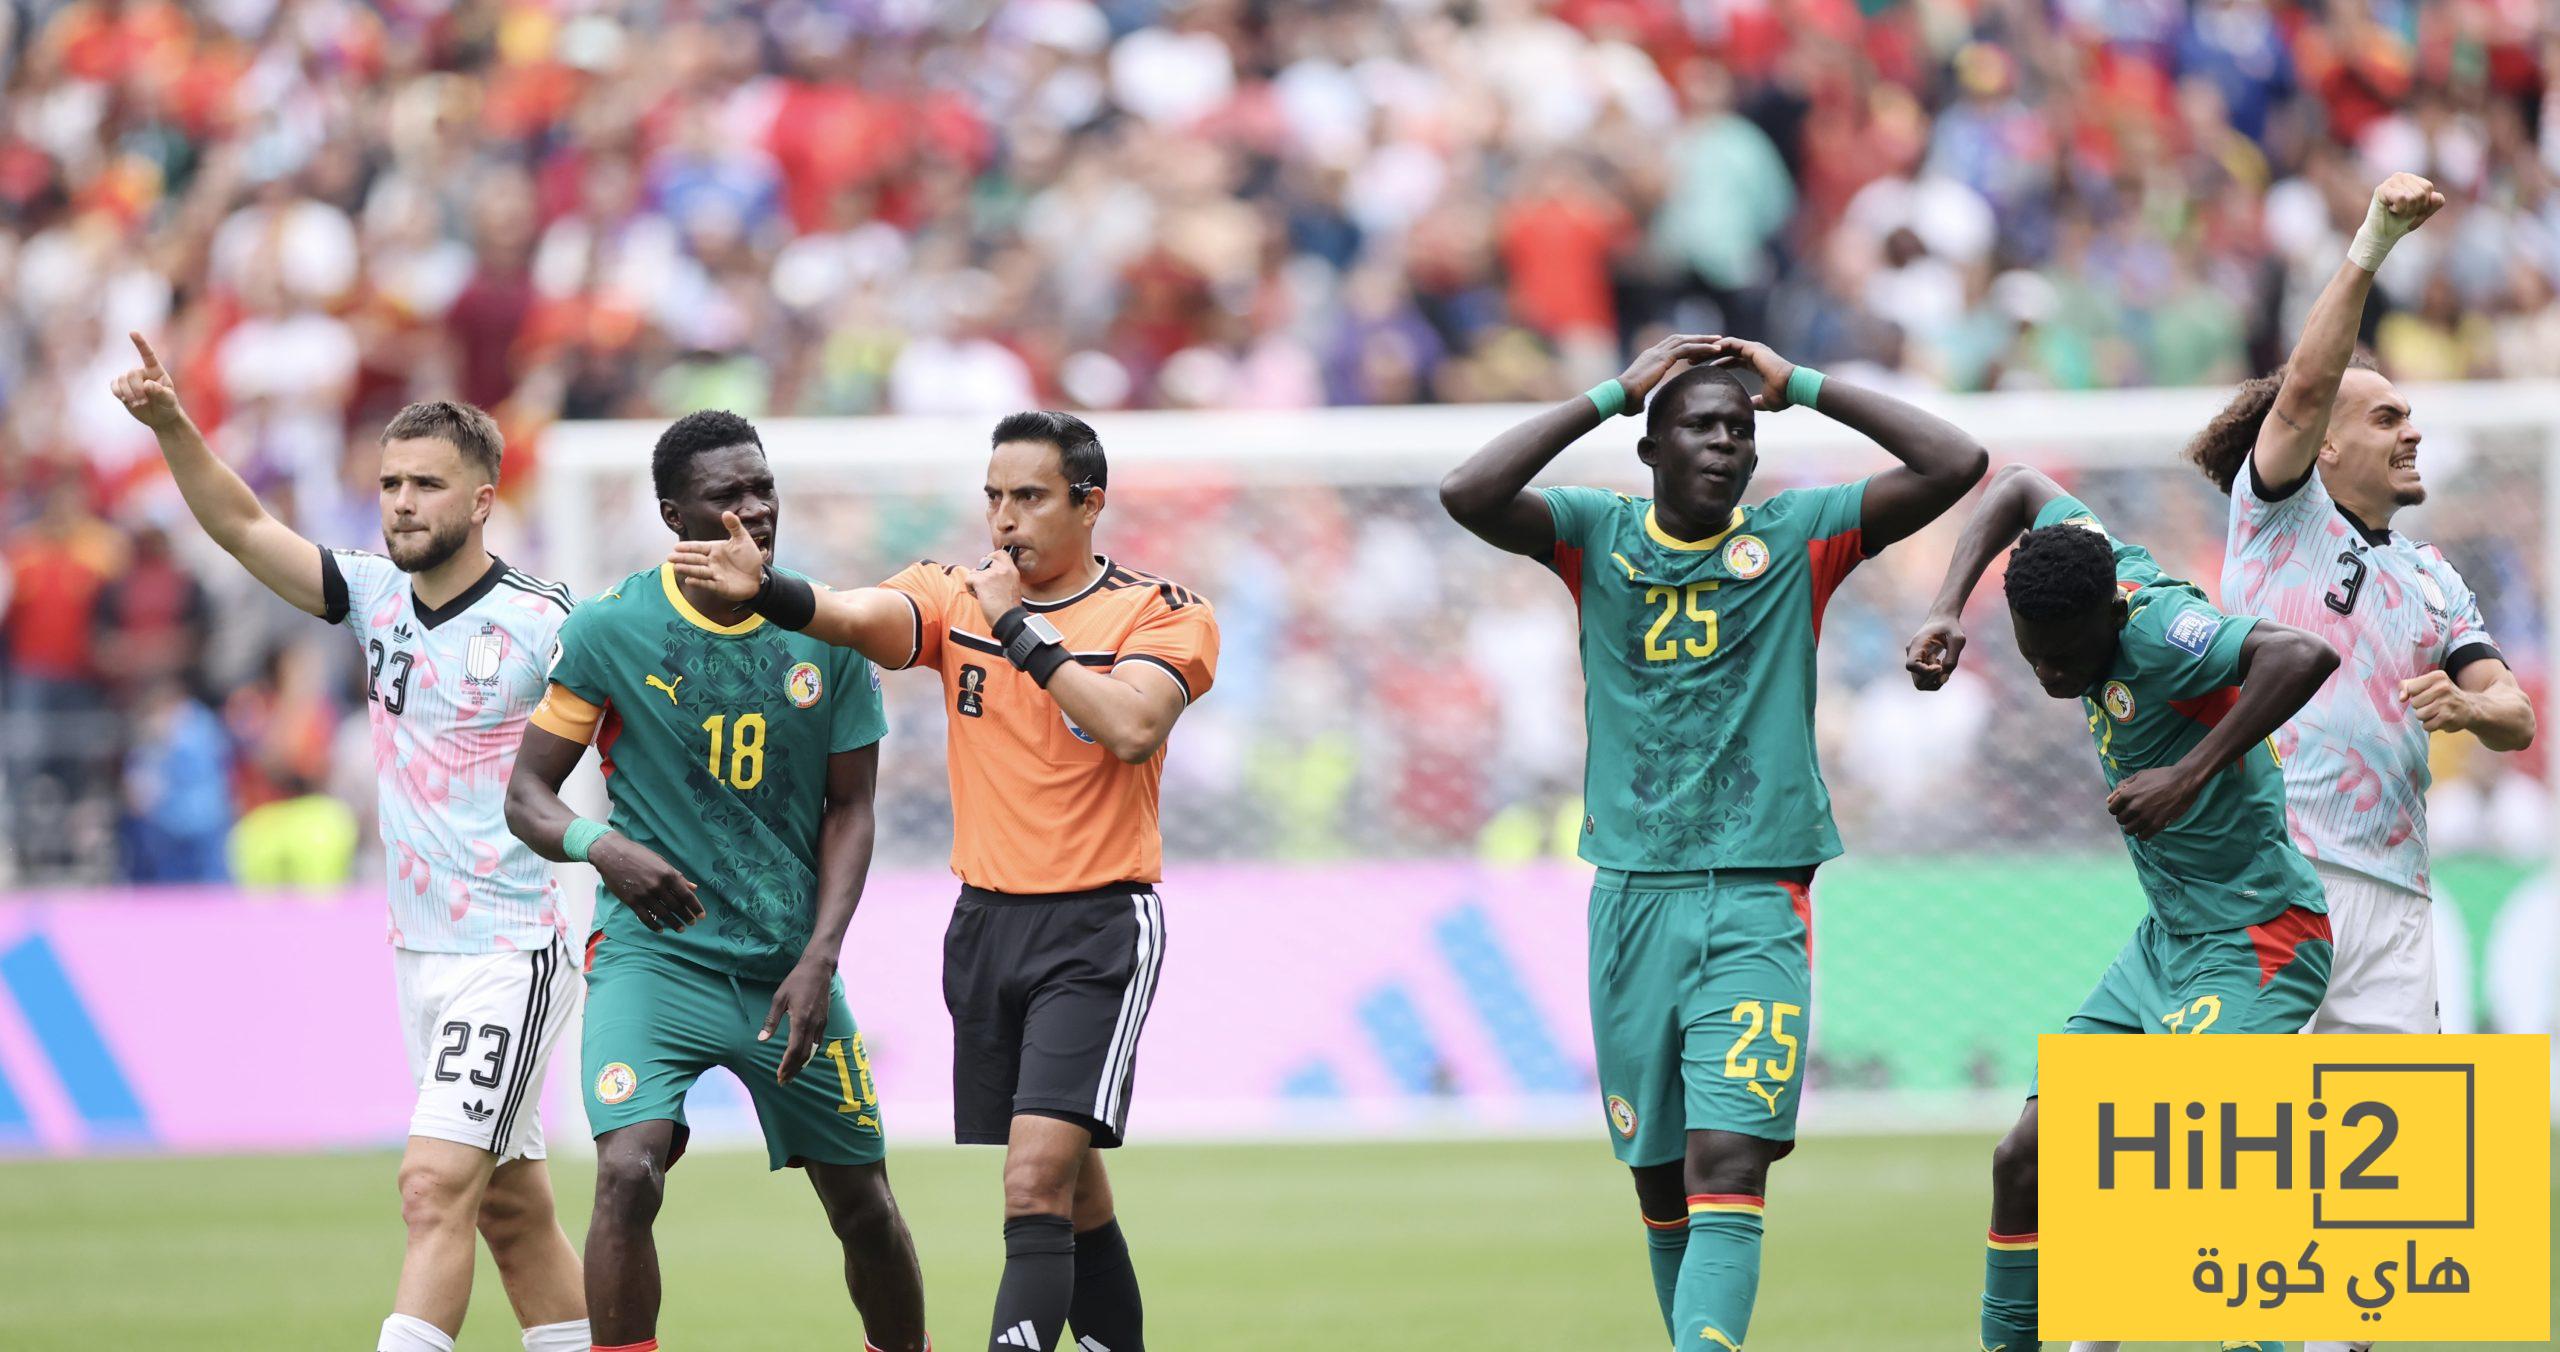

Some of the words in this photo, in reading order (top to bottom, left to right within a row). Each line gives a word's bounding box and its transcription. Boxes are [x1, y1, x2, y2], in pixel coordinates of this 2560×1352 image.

[1644, 580, 1720, 661] 25
[2324, 551, 2368, 618] 3
[368, 637, 416, 718] 23
[963, 704, 978, 714] FIFA
[701, 712, 766, 790] 18
[435, 1021, 512, 1090] 23
[824, 1031, 877, 1113] 18
[1723, 1001, 1802, 1082] 25
